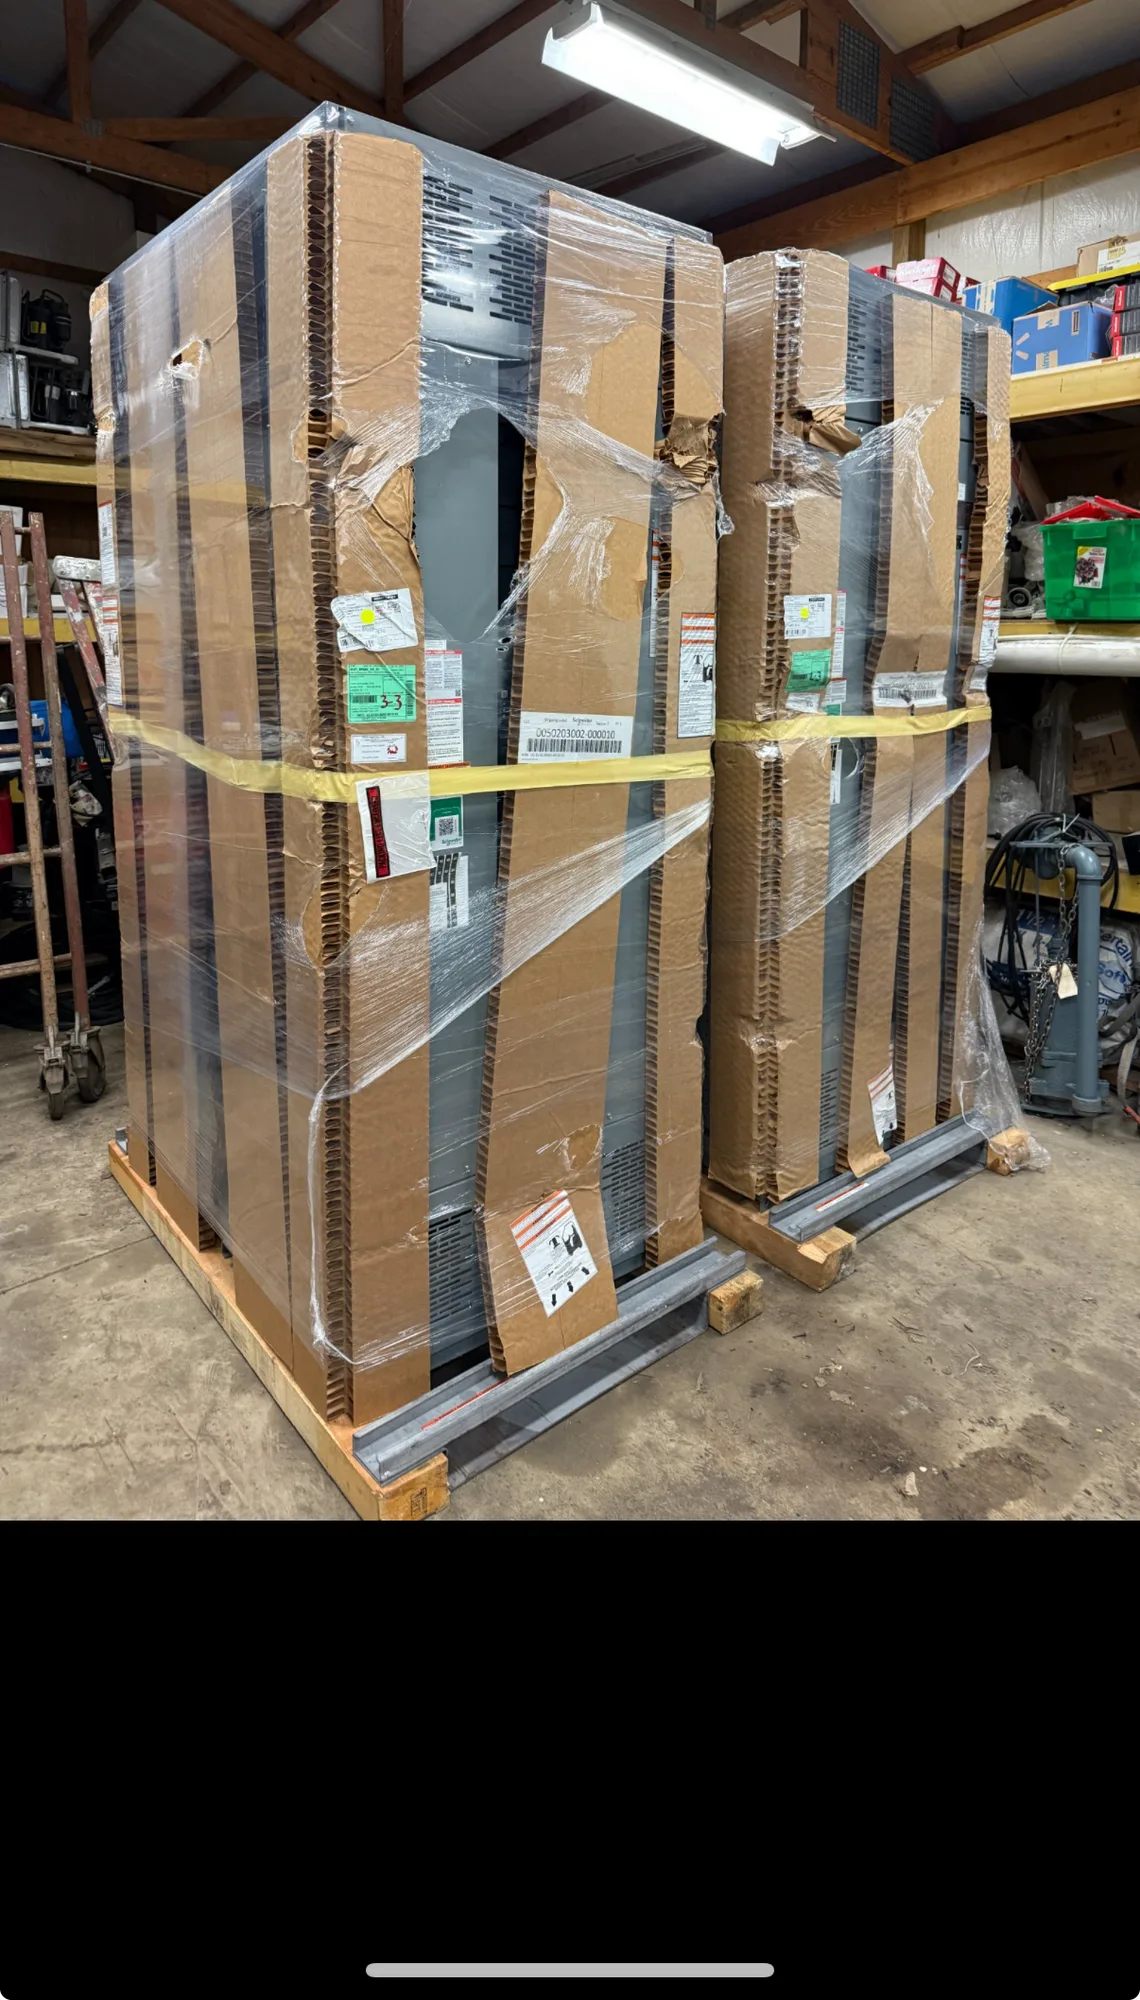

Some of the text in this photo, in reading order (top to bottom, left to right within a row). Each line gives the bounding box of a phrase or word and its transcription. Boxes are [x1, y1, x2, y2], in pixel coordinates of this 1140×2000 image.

[381, 694, 402, 711] 3-3
[374, 829, 384, 842] LIST
[376, 843, 388, 869] PACKING
